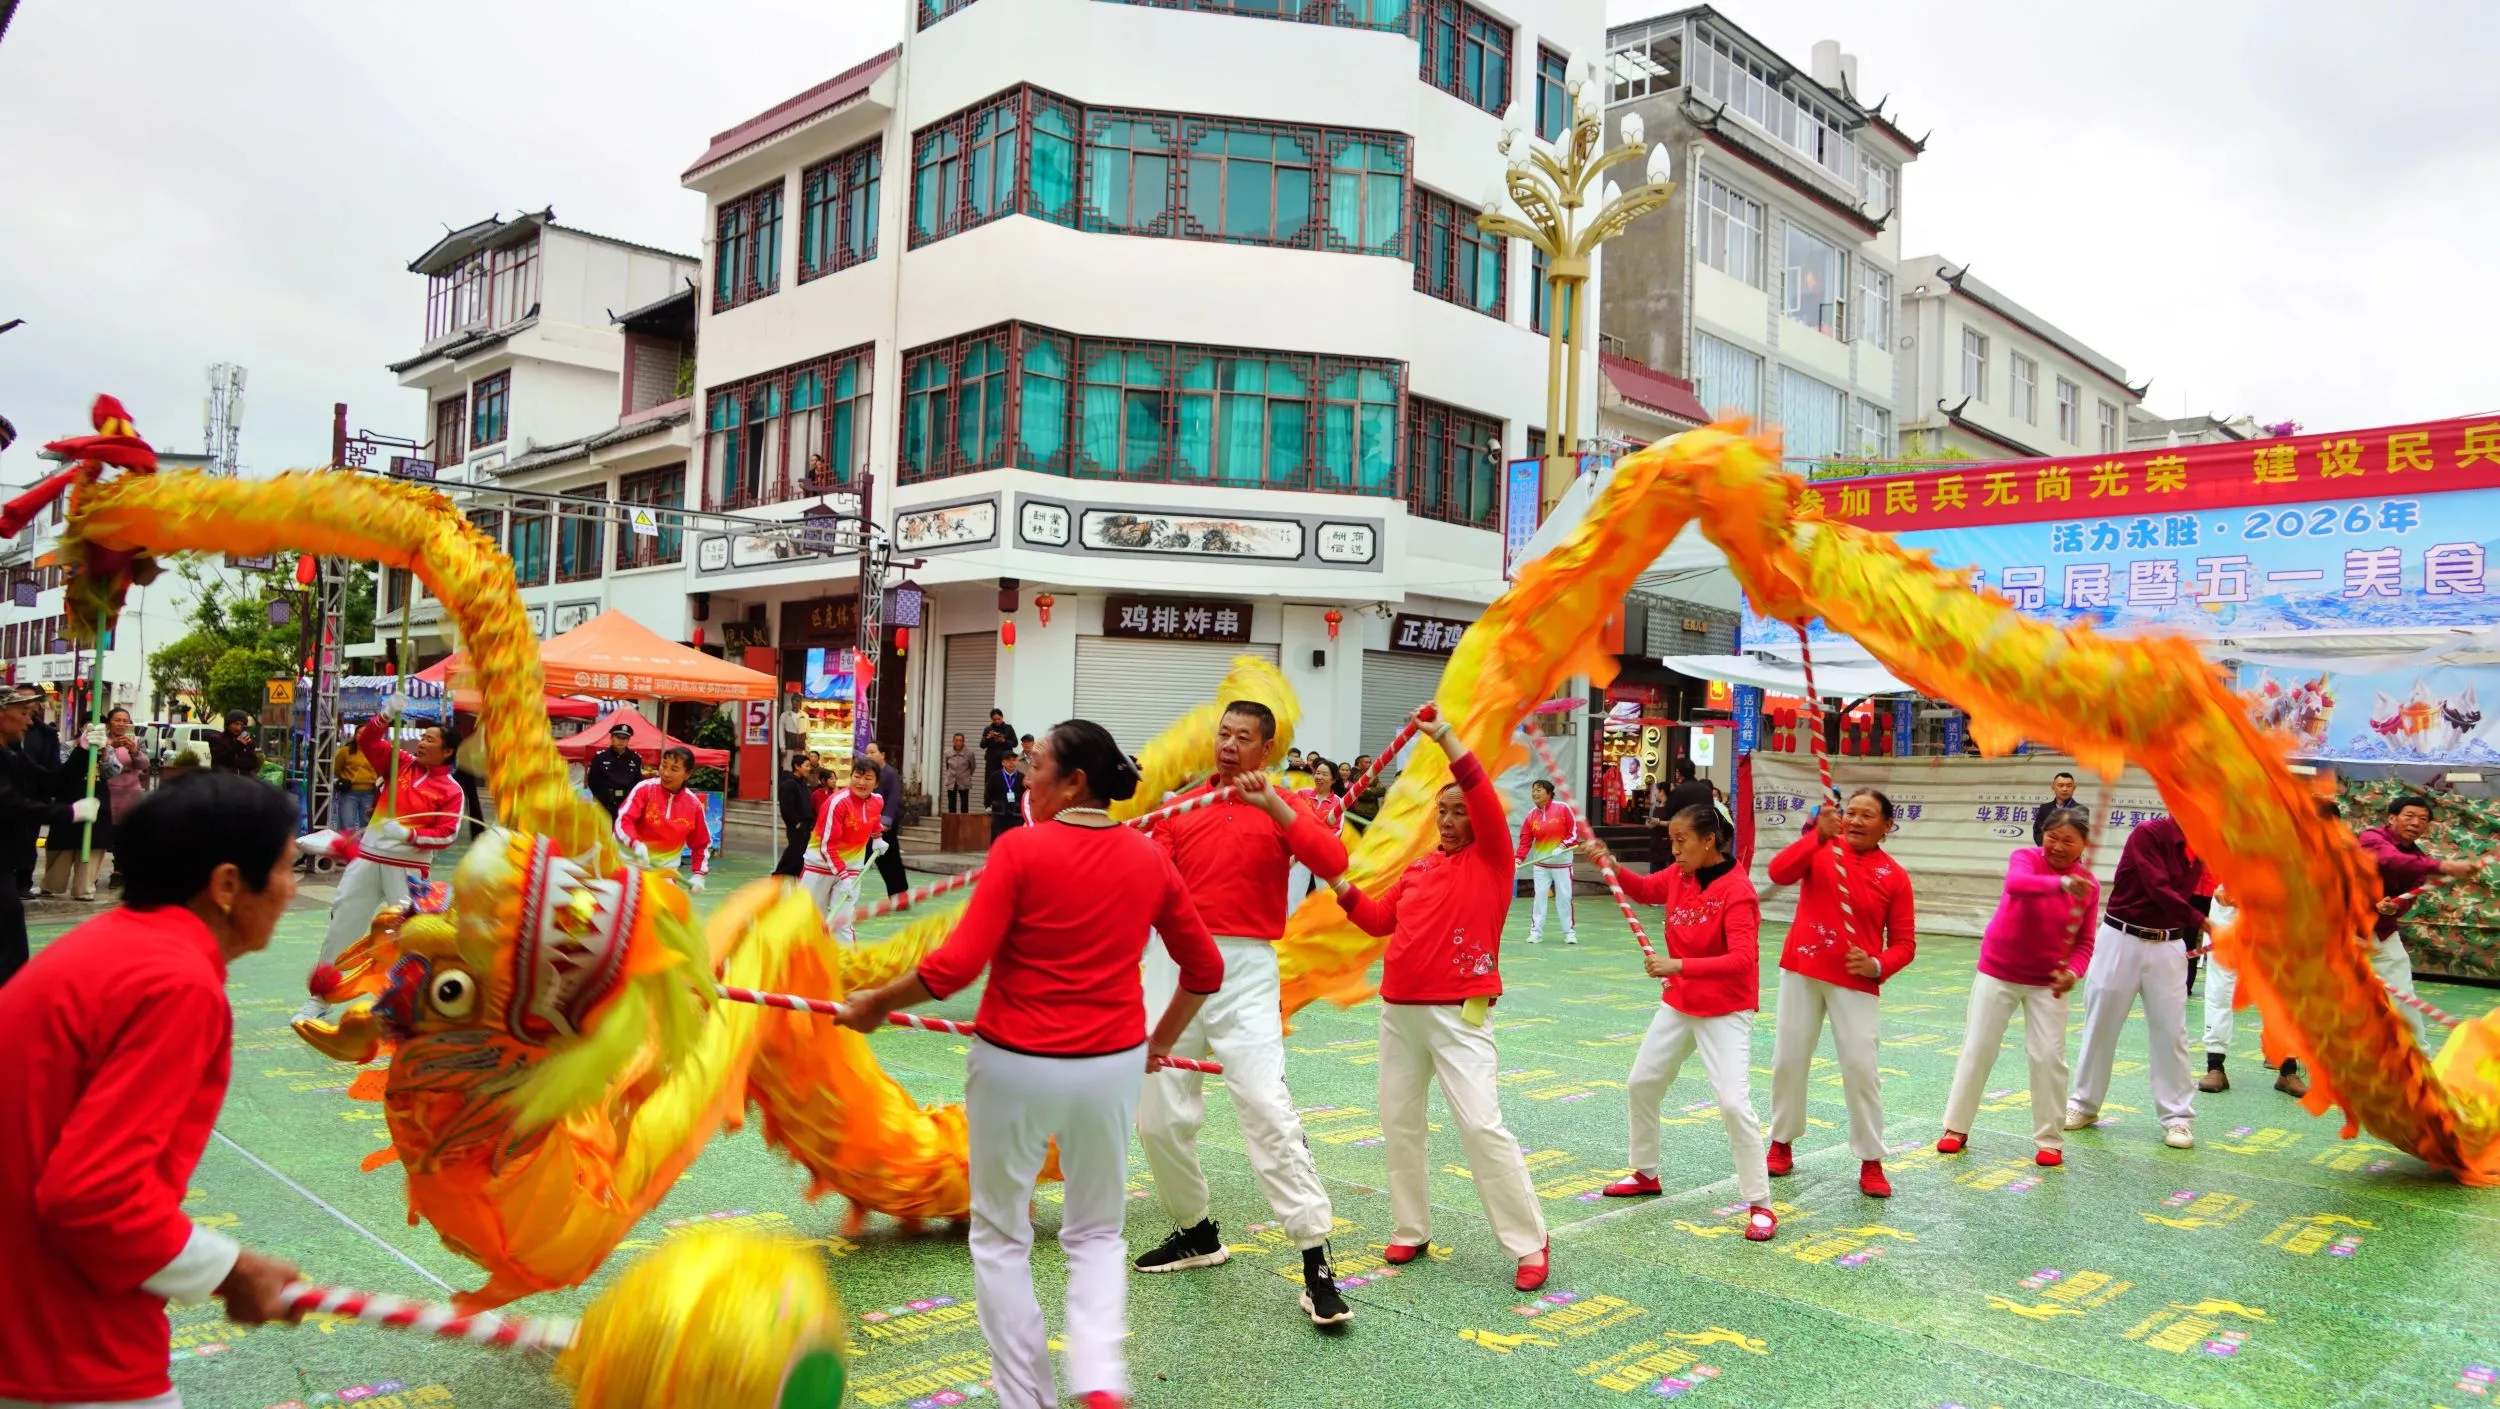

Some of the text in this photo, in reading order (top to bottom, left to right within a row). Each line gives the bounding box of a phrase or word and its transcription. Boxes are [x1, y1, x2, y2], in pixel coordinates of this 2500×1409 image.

[1793, 422, 2500, 517] 参加民兵无尚光荣 建设民兵
[1120, 604, 1239, 635] 鸡排炸串
[1398, 619, 1469, 650] 正新鸡
[749, 702, 766, 727] 5
[1743, 694, 1754, 741] 活力永胜
